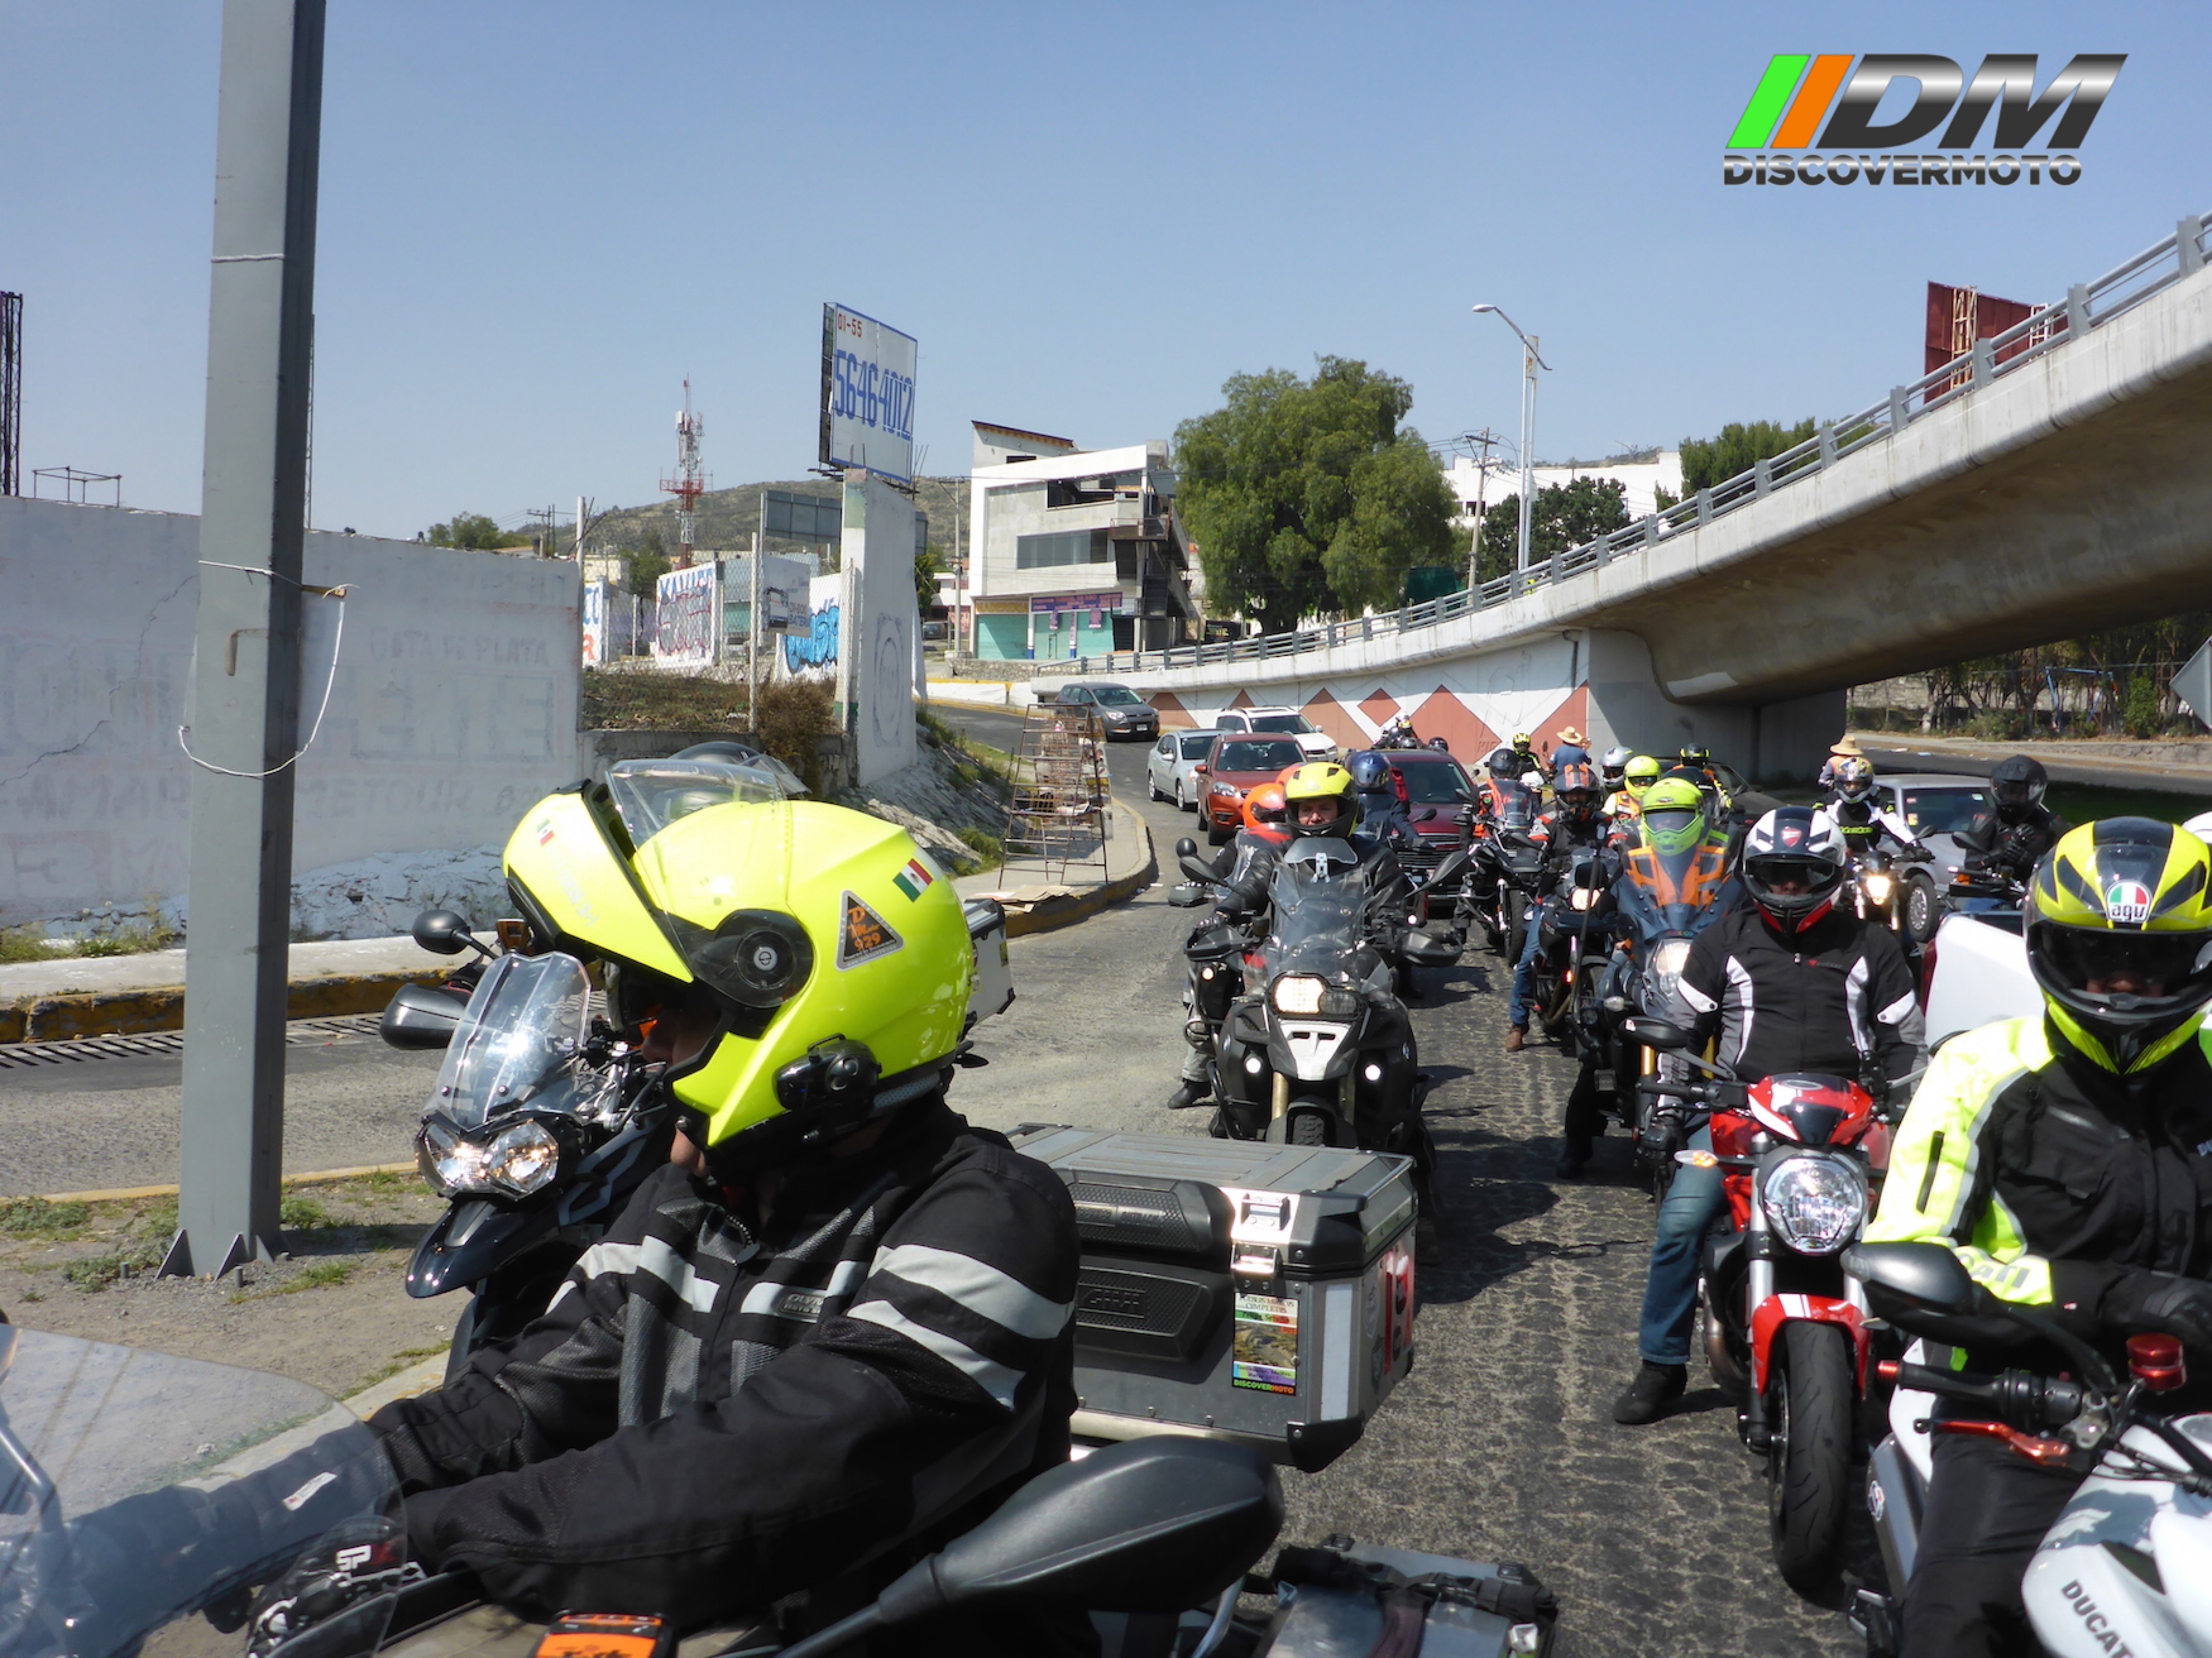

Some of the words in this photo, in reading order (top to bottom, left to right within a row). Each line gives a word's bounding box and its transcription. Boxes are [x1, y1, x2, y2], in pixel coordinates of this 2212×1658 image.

[837, 313, 863, 338] 01-55
[2112, 904, 2146, 921] agv
[1234, 1379, 1294, 1395] DISCOVERMOTO
